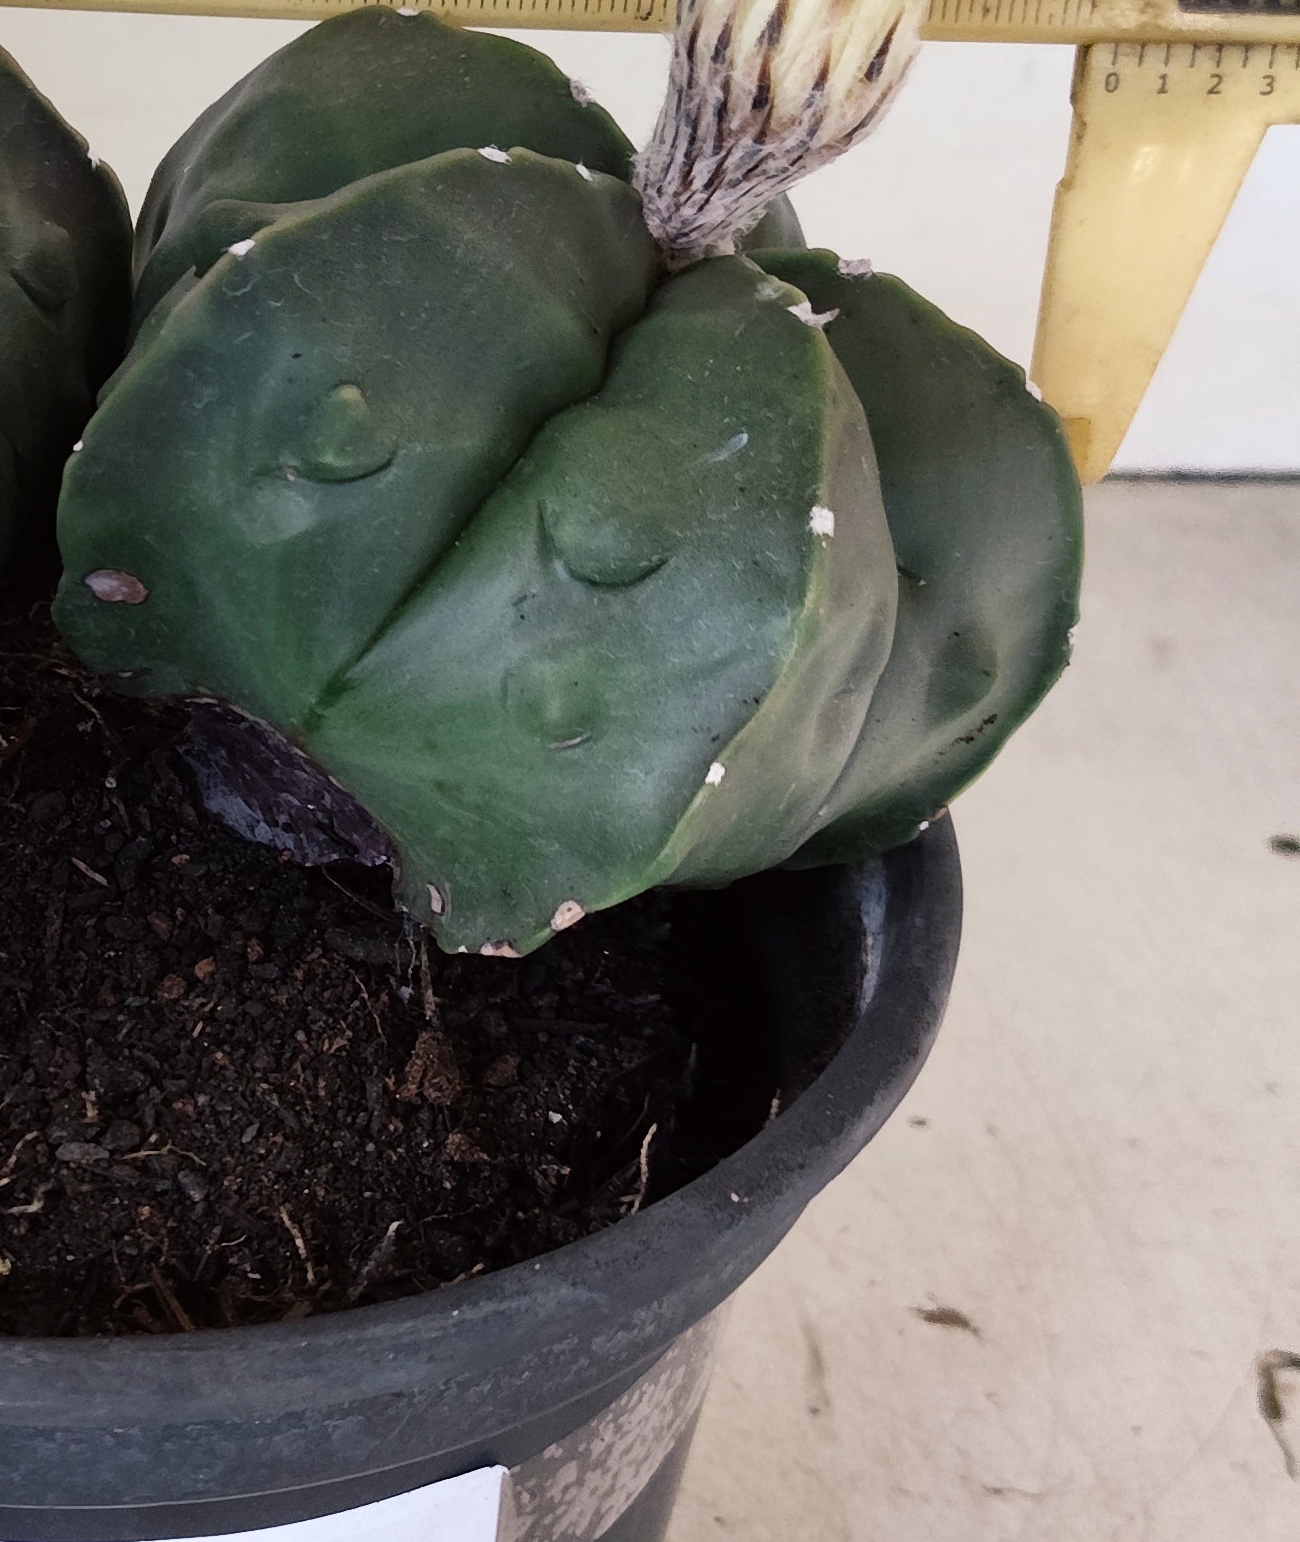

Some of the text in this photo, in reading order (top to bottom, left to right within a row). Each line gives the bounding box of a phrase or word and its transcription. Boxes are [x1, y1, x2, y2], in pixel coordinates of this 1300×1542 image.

[1104, 72, 1276, 96] 0 1 2 3
